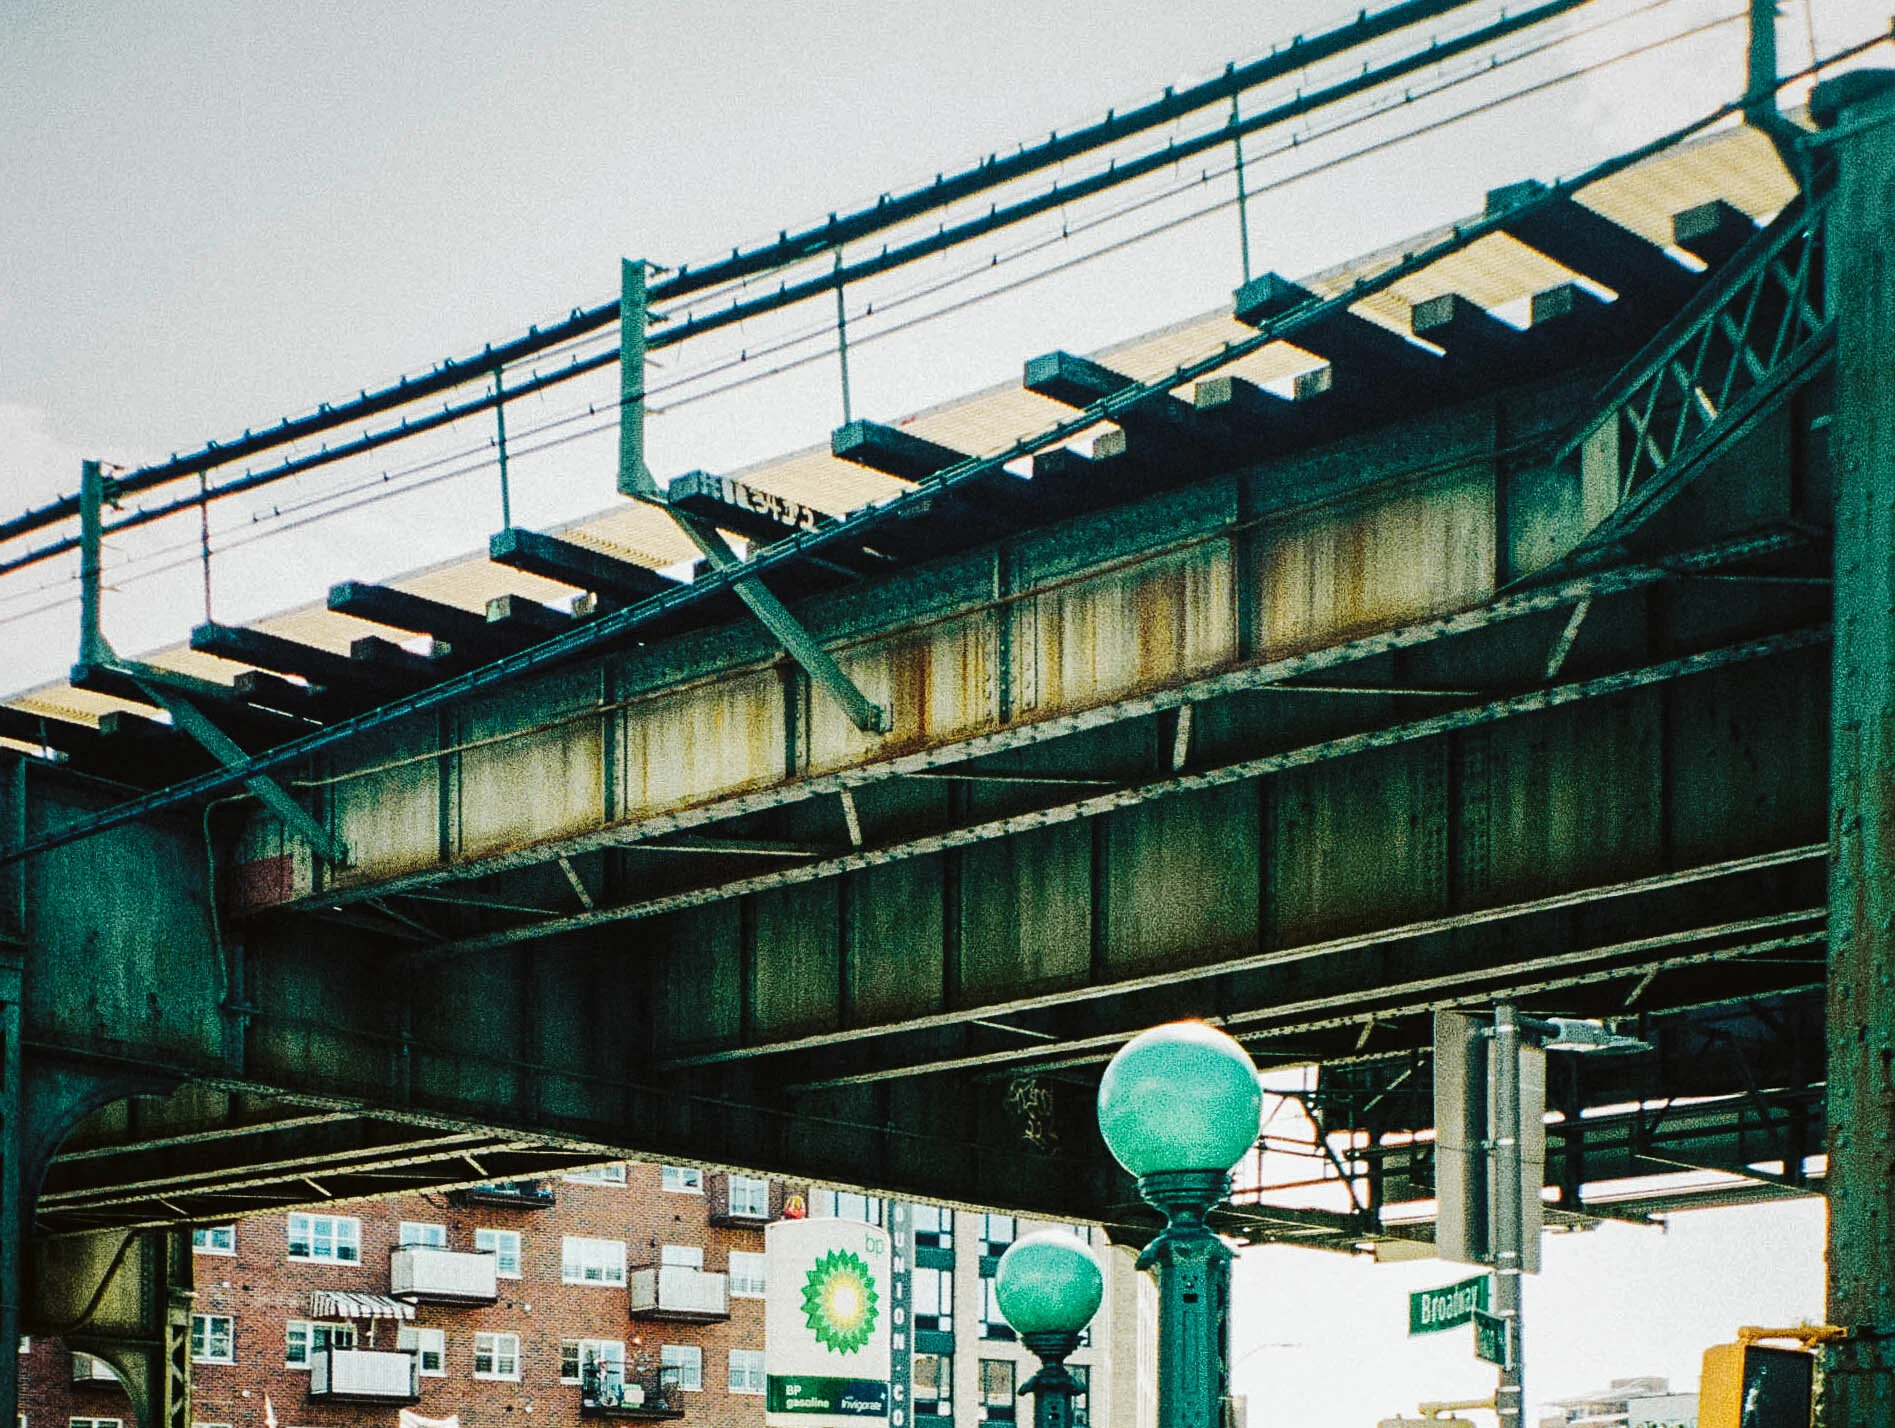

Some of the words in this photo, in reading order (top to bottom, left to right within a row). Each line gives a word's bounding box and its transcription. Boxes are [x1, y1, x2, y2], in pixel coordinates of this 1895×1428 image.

[865, 1235, 884, 1256] bp
[1421, 1285, 1479, 1325] Broadway
[785, 1384, 802, 1396] BP
[785, 1397, 829, 1409] gasoline
[841, 1399, 882, 1412] Invigorate
